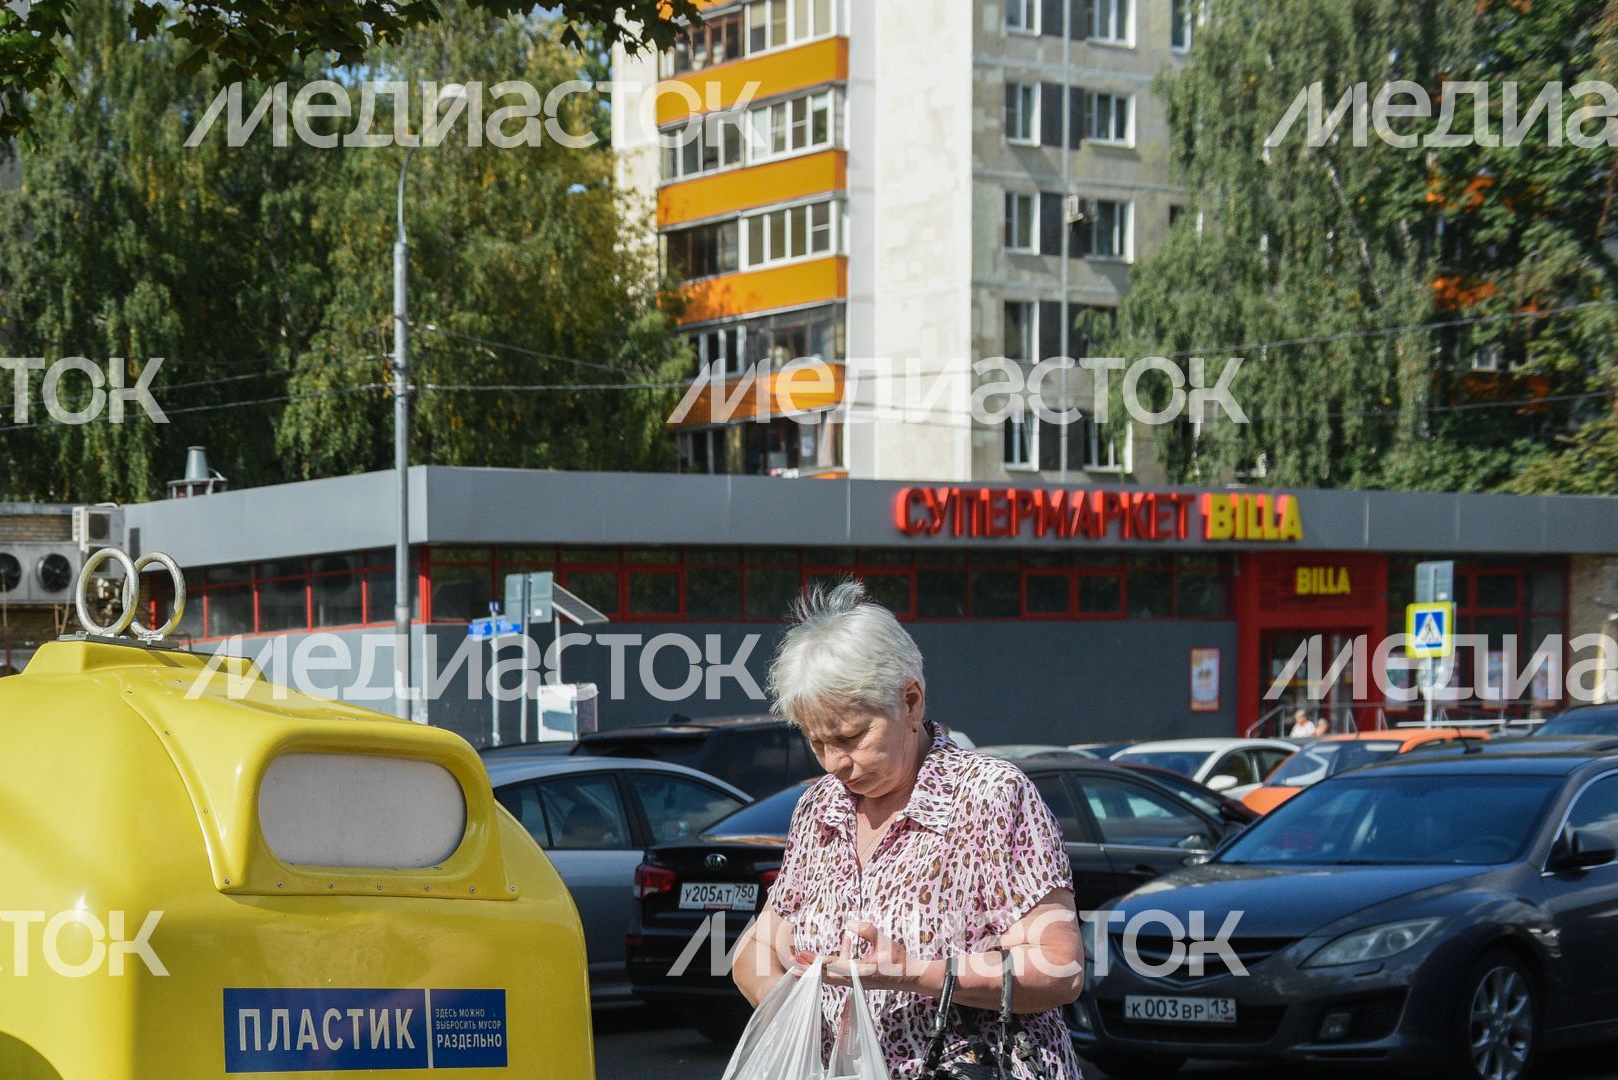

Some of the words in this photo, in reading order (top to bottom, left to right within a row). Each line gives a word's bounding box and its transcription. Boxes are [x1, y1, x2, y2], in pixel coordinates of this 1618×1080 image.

[895, 486, 1197, 539] СУПЕРМАРКЕТ
[1201, 491, 1304, 541] BILLA
[1295, 566, 1351, 595] BILLA
[435, 1008, 456, 1018] ЗДЕСЬ
[459, 1008, 484, 1017] МОЖНО
[238, 1008, 413, 1051] ПЛАСТИК
[436, 1020, 475, 1029] ВЫБРОСИТЬ
[478, 1020, 500, 1029] МУСОР
[437, 1033, 501, 1049] РАЗДЕЛЬНО
